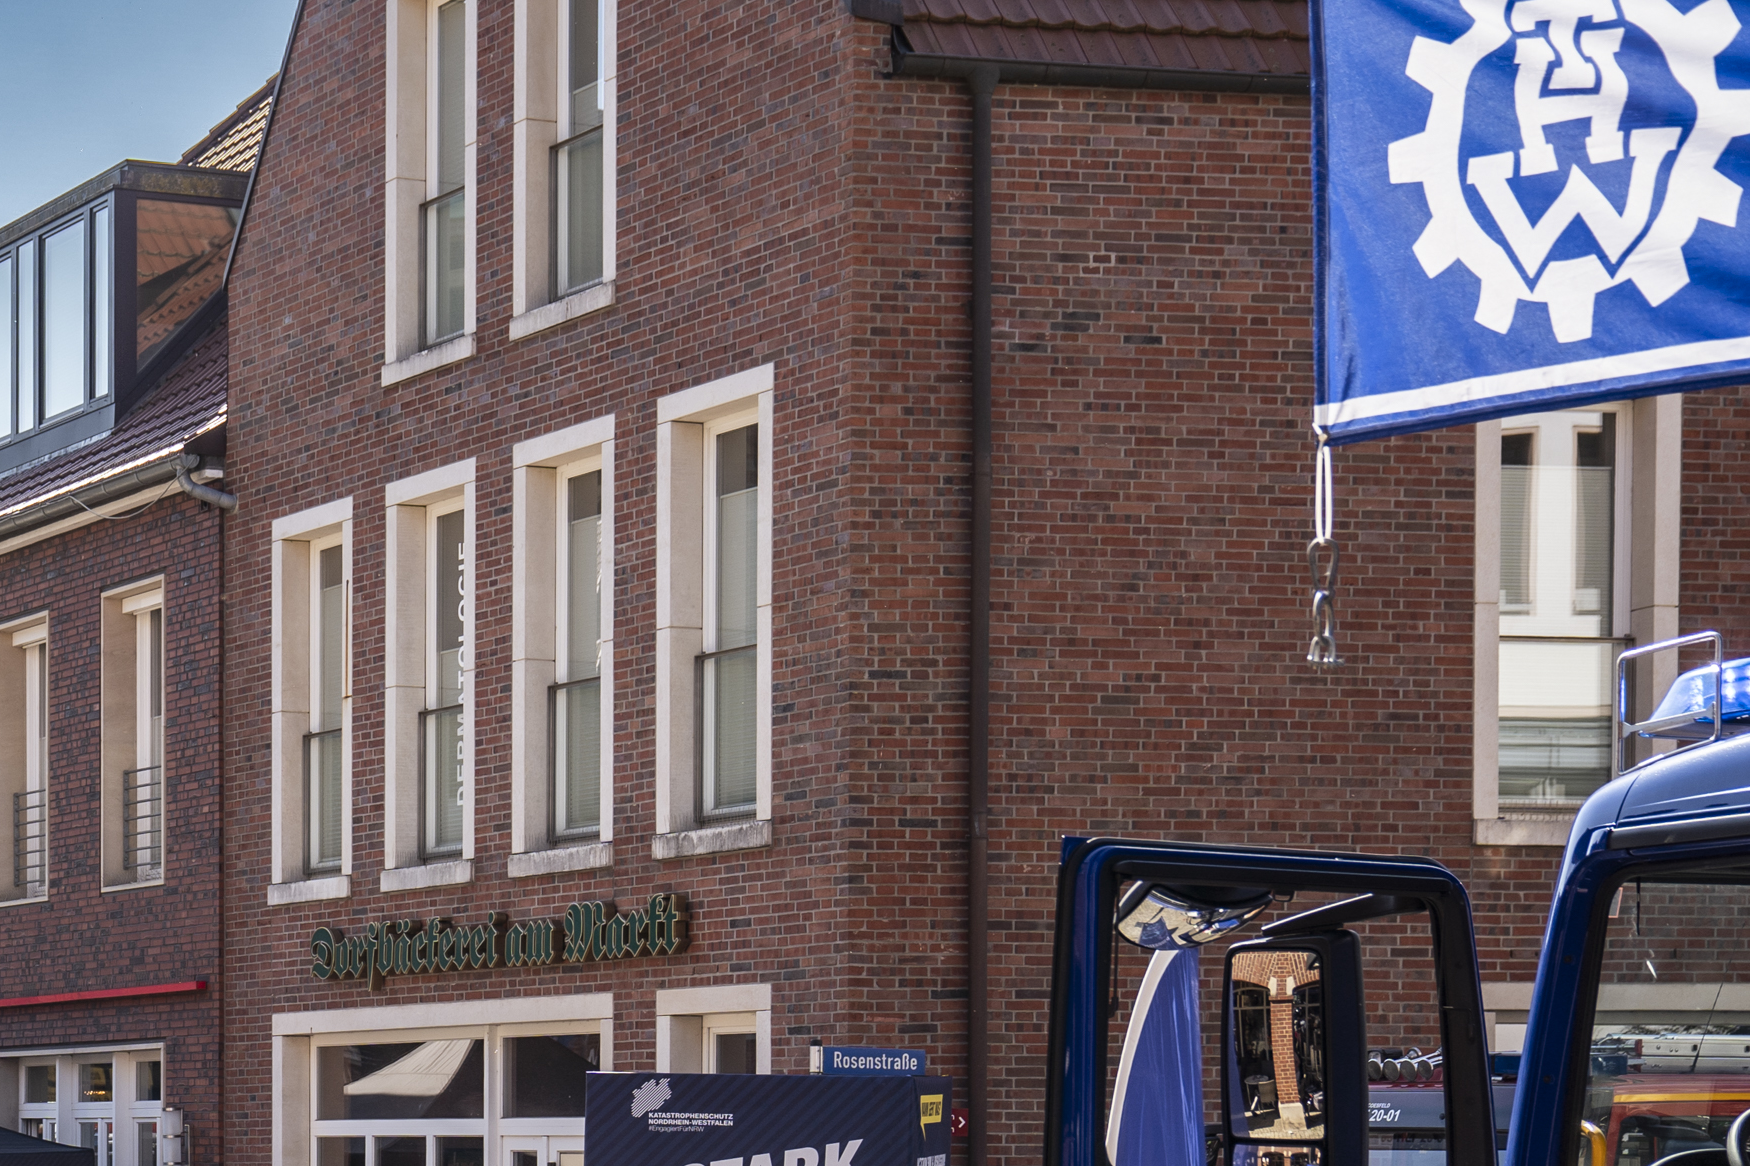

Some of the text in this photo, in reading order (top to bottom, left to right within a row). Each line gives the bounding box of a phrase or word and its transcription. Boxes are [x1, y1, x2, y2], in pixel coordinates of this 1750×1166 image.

[310, 892, 681, 992] Dorfbäckerei am Markt
[833, 1051, 918, 1070] Rosenstraße
